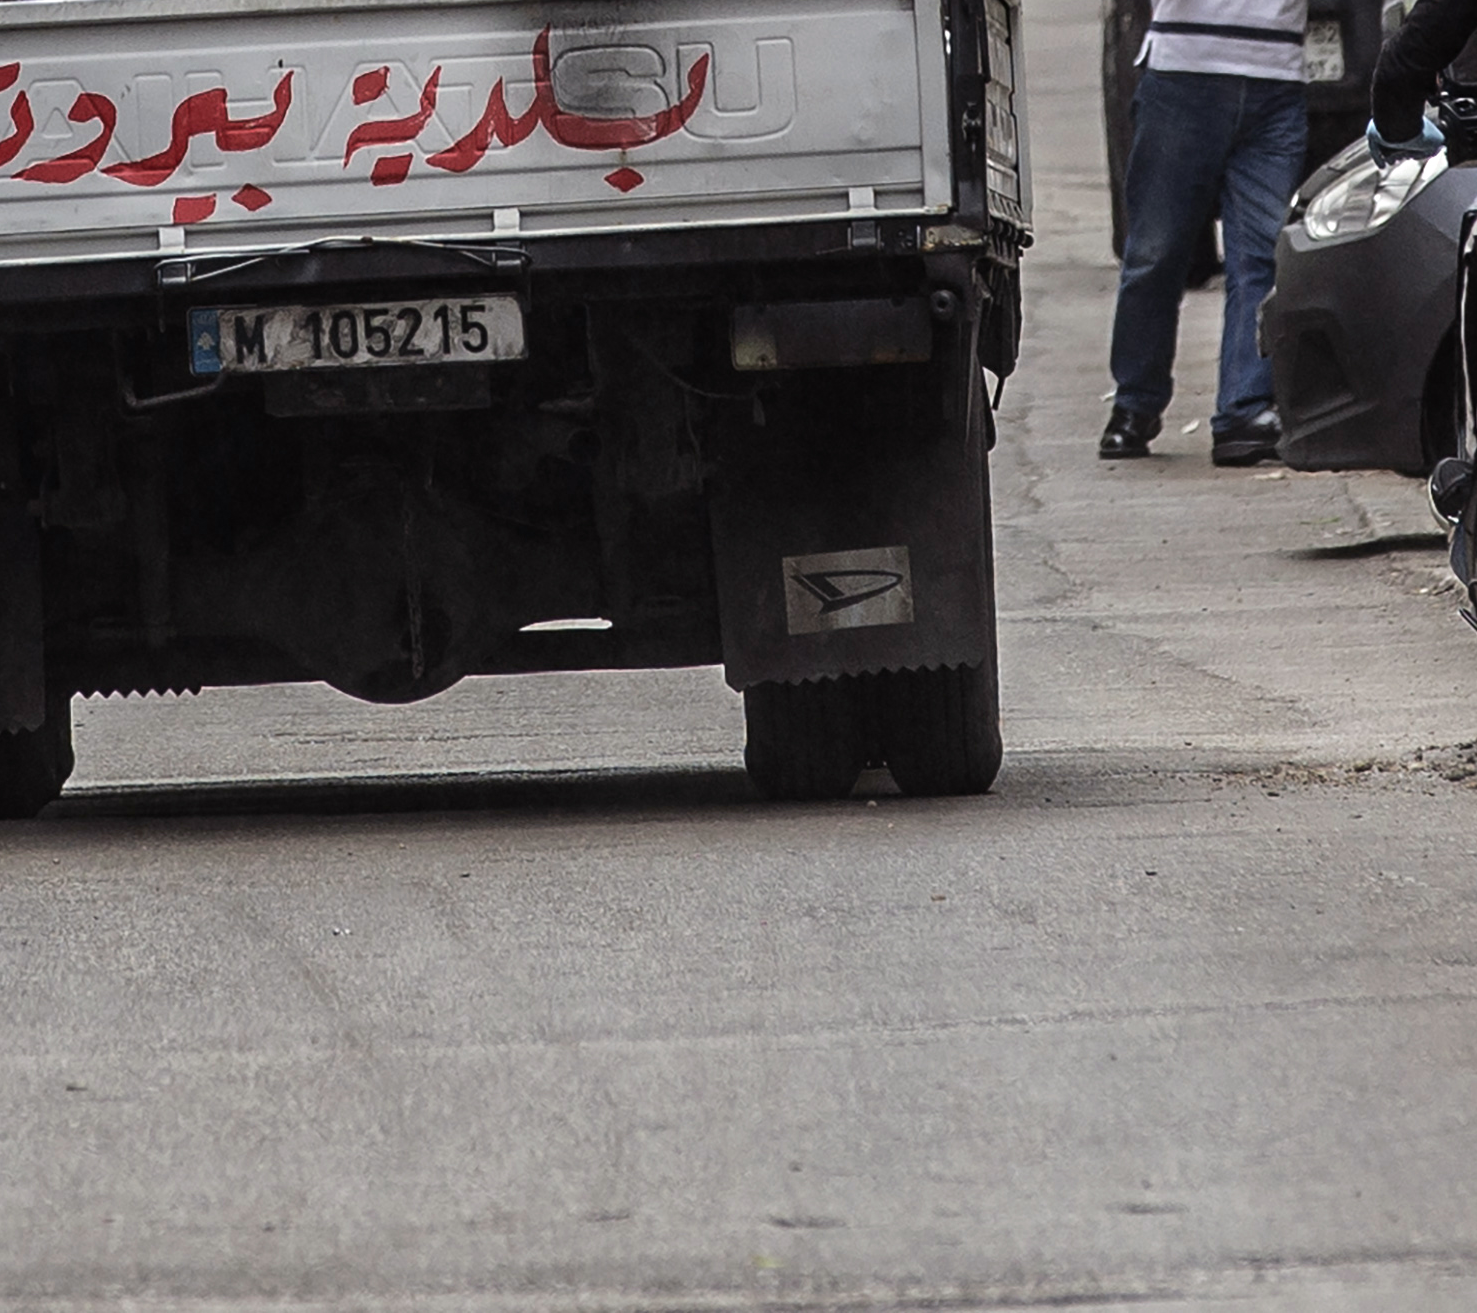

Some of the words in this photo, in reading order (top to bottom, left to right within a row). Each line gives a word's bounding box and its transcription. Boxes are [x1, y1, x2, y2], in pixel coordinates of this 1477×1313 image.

[343, 22, 711, 193] بلدية
[234, 314, 266, 365] M
[303, 302, 489, 360] 105215
